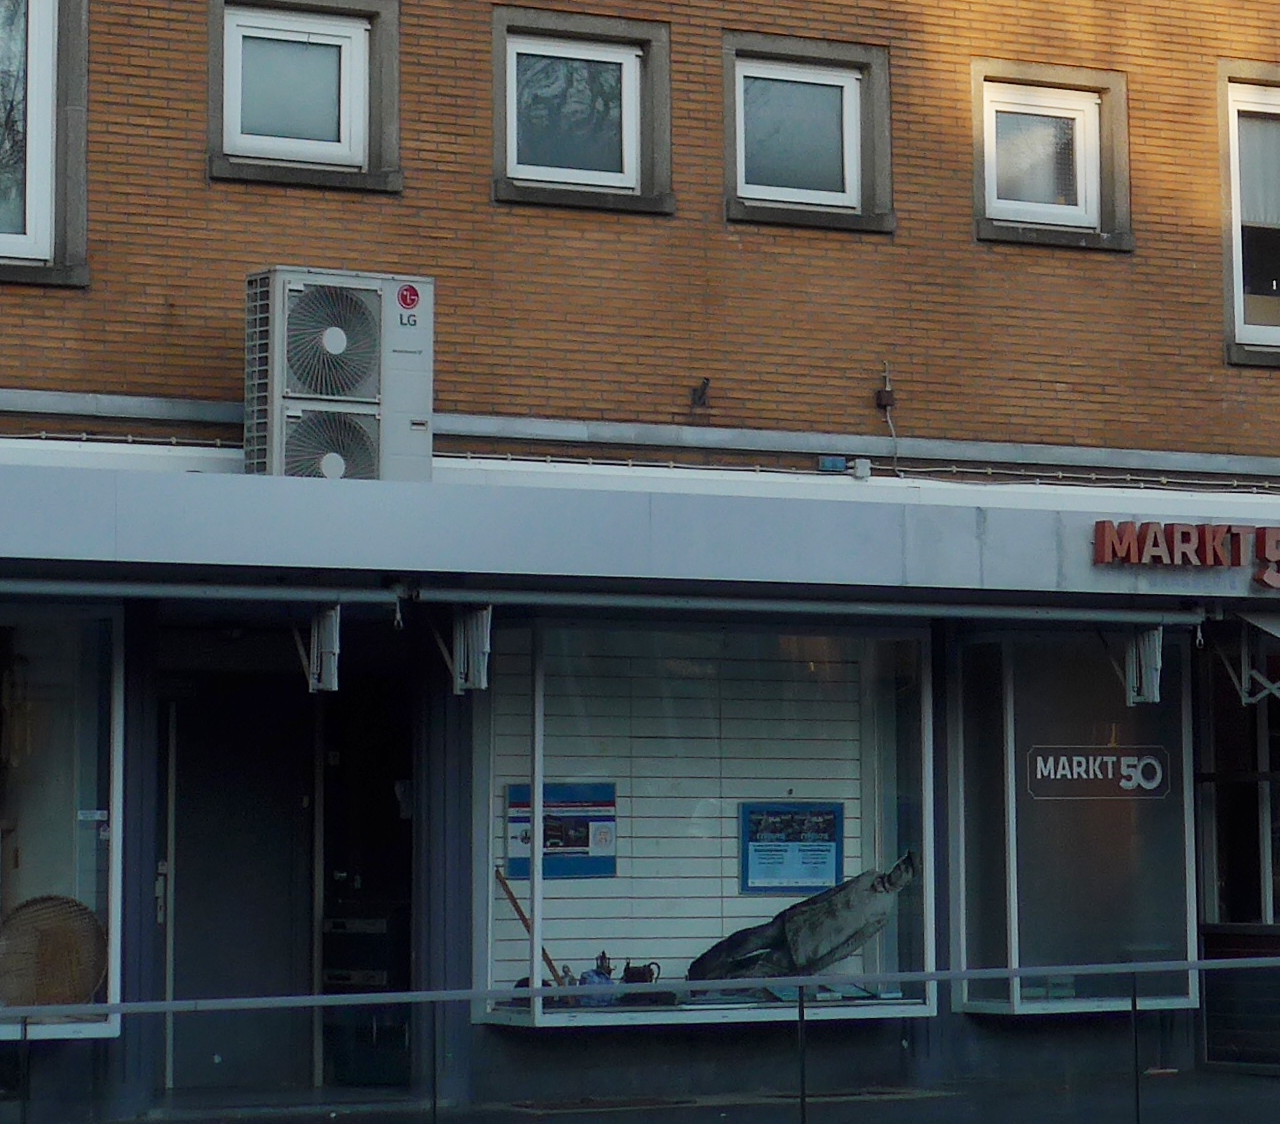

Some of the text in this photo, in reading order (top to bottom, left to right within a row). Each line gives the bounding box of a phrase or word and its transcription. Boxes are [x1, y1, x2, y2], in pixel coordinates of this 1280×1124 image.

[399, 313, 417, 327] LG
[1095, 520, 1256, 567] MARKT
[1036, 755, 1163, 790] MARKT 50
